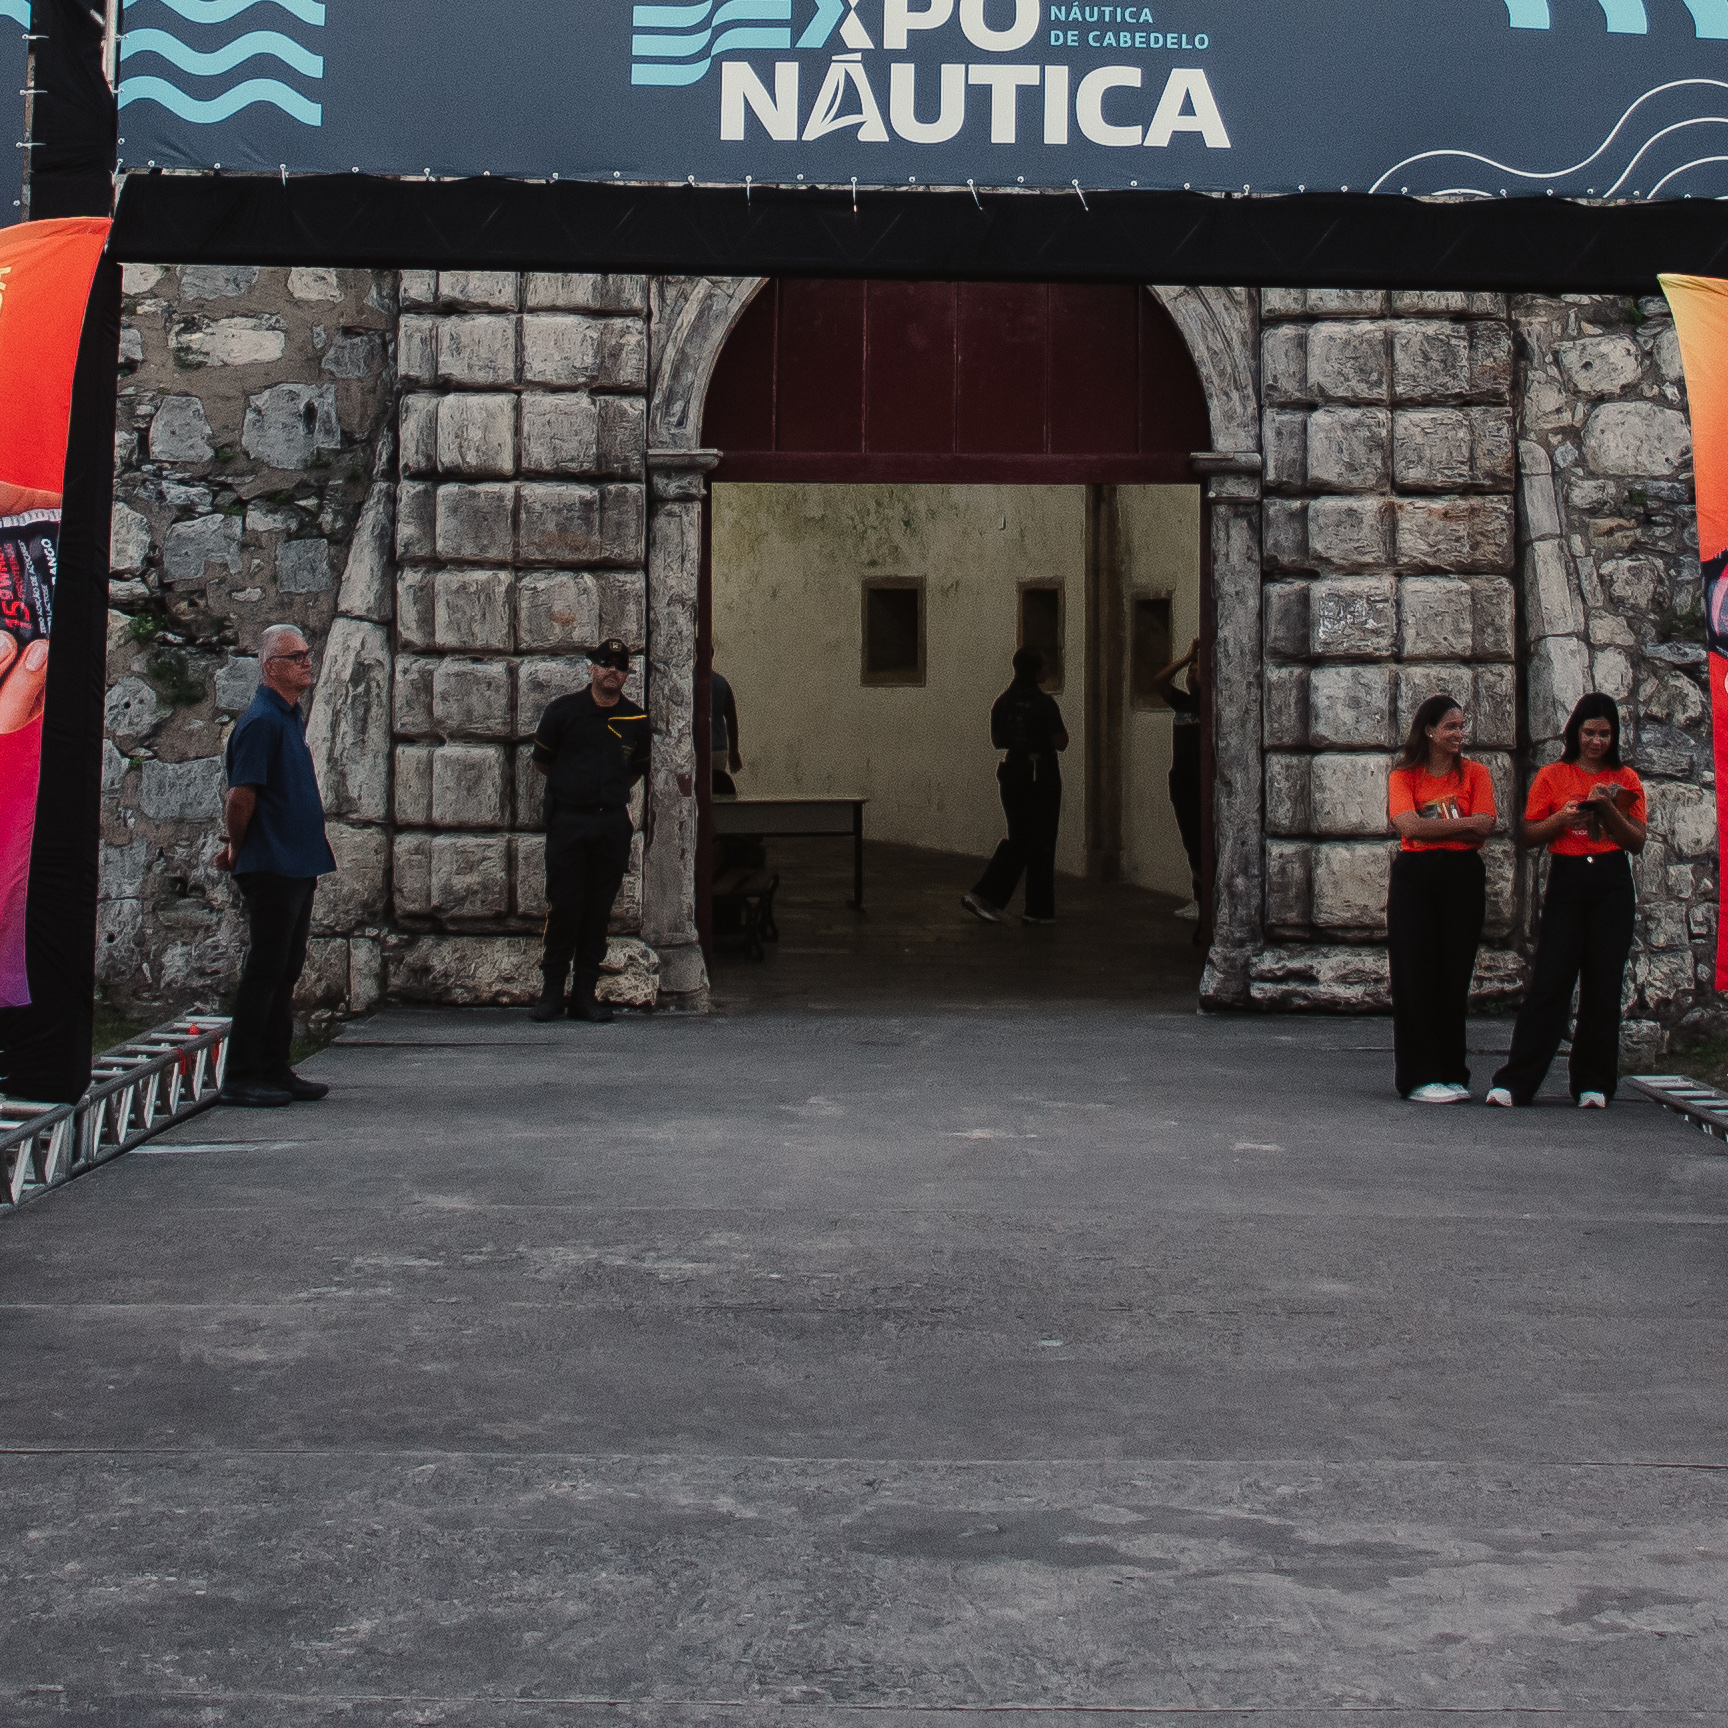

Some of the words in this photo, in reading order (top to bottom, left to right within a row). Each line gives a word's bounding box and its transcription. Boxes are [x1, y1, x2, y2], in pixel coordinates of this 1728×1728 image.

[1050, 1, 1154, 23] NÁUTICA
[1050, 30, 1079, 46] DE
[1088, 31, 1210, 50] CABEDELO
[720, 52, 1231, 148] NÁUTICA
